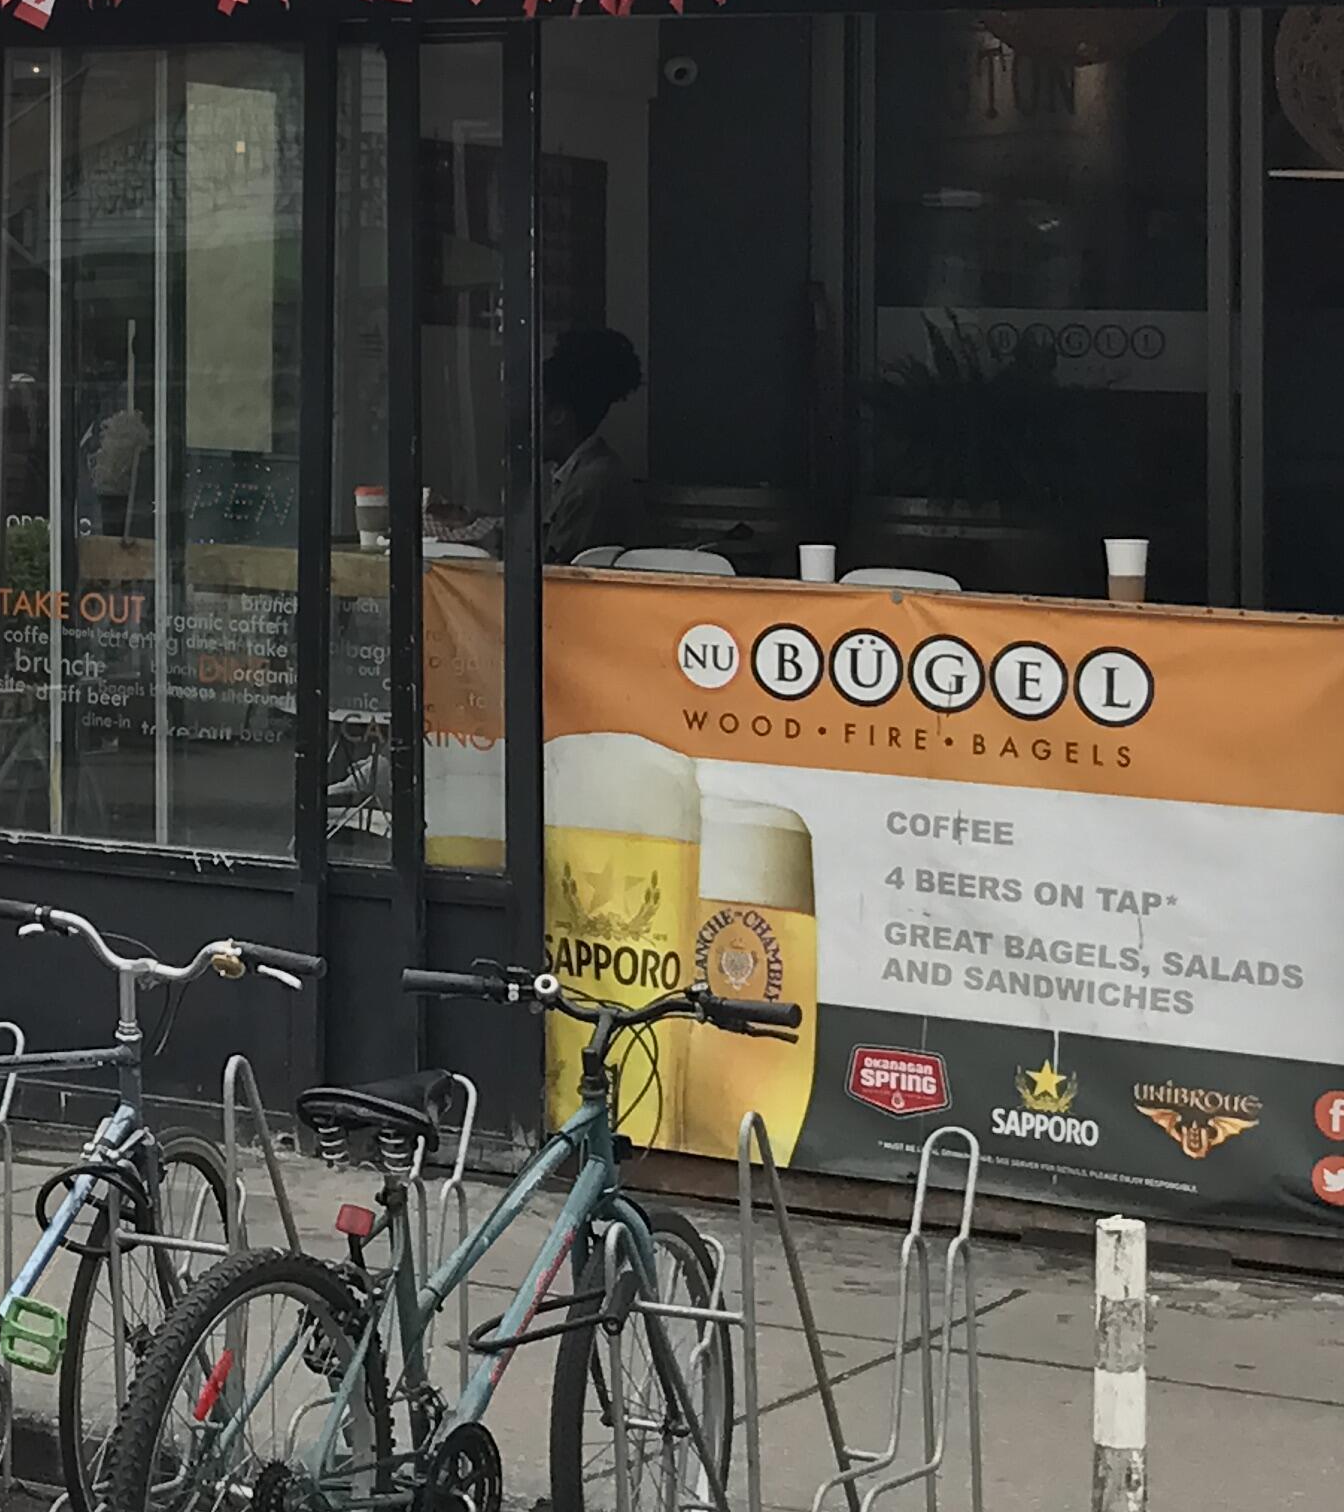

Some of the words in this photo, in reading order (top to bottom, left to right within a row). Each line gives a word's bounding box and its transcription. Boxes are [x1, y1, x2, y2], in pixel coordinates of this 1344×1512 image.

[0, 588, 70, 620] TAKE
[80, 592, 146, 624] OUT
[683, 642, 734, 672] NU
[774, 638, 1132, 709] BÜGEL
[87, 686, 130, 706] beer
[683, 709, 802, 740] WOOD
[844, 723, 928, 751] FIRE
[972, 733, 1133, 769] BAGELS
[886, 810, 1014, 846] COFFEE
[885, 865, 905, 890] 4
[915, 868, 1023, 903] BEERS
[1034, 881, 1084, 909] ON
[884, 921, 994, 955] GREAT
[1004, 934, 1151, 979] BAGELS,
[1162, 951, 1305, 990] SALADS
[881, 957, 953, 987] AND
[963, 965, 1195, 1015] SANDWICHES
[992, 1106, 1100, 1148] SAPPORO
